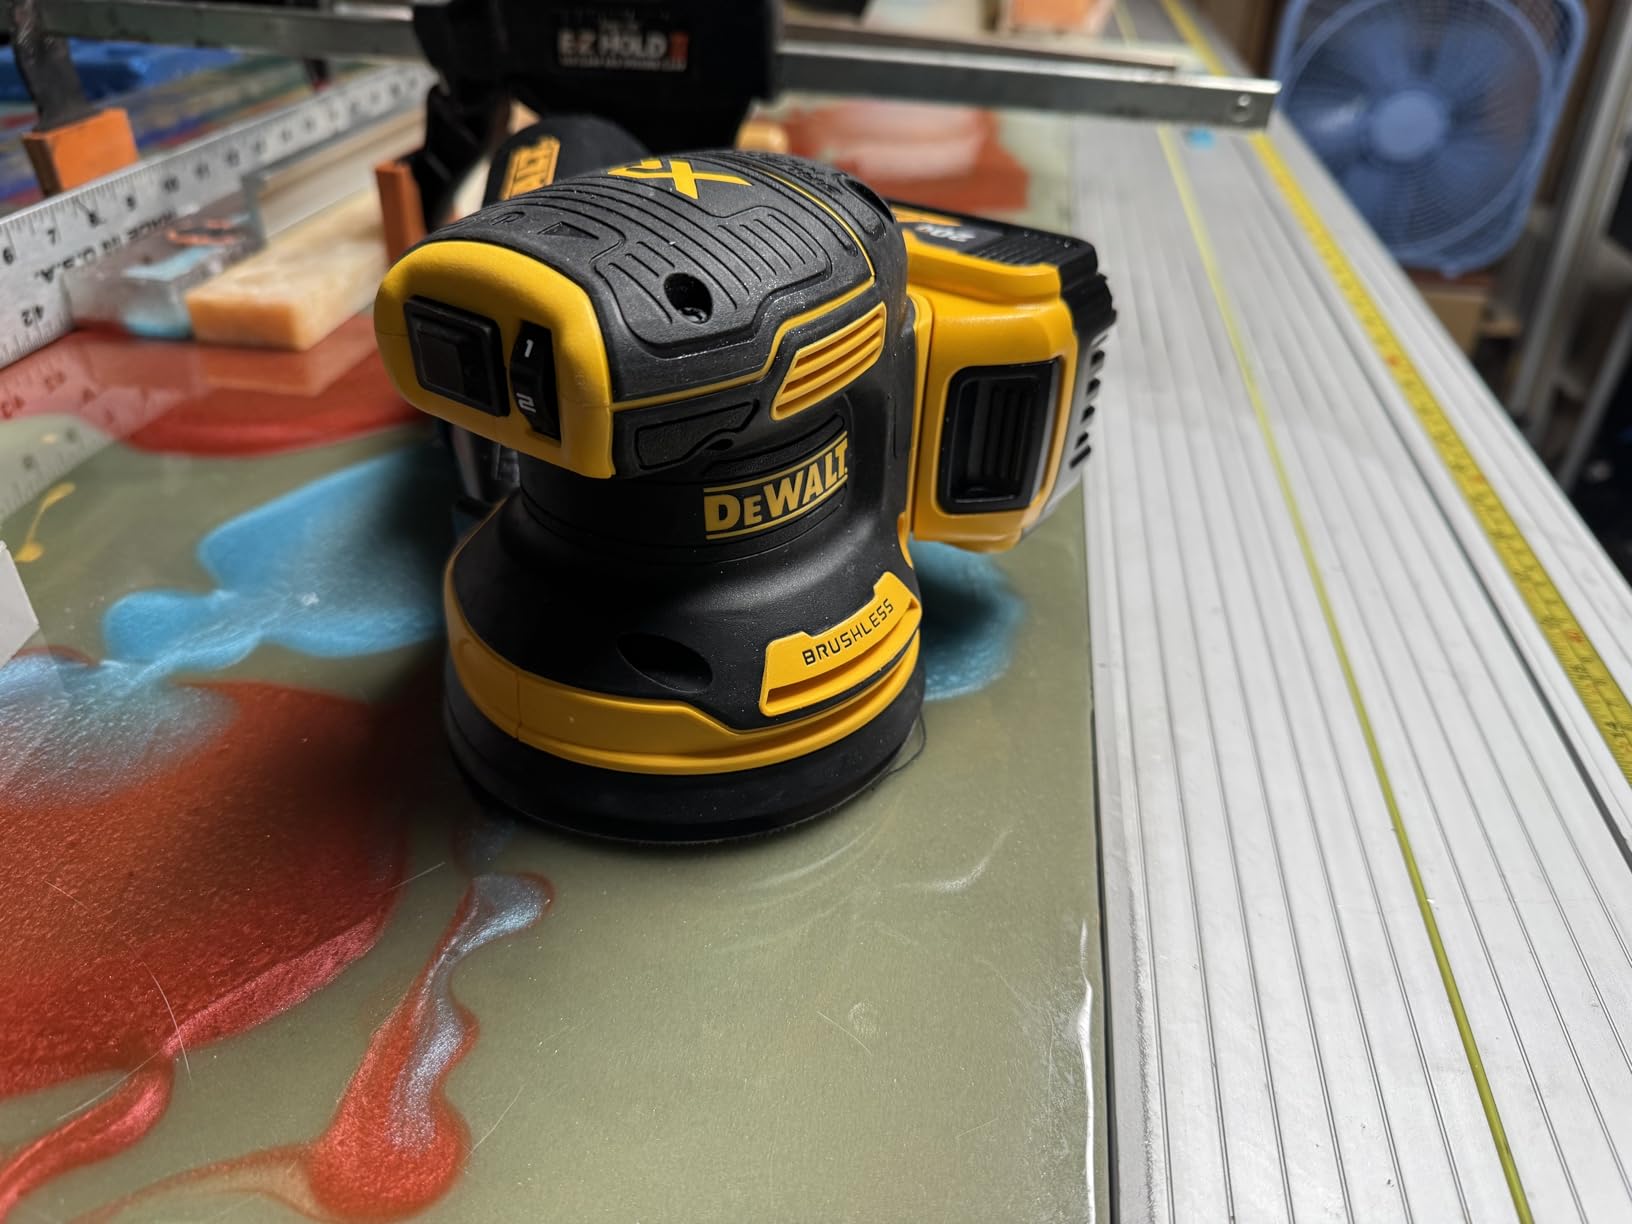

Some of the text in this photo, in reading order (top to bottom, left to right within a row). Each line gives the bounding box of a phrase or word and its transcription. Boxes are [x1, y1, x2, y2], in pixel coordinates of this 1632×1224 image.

[599, 30, 668, 59] HOLD
[524, 338, 534, 358] 1
[515, 392, 537, 413] 2
[801, 598, 894, 666] BRUSHLESS
